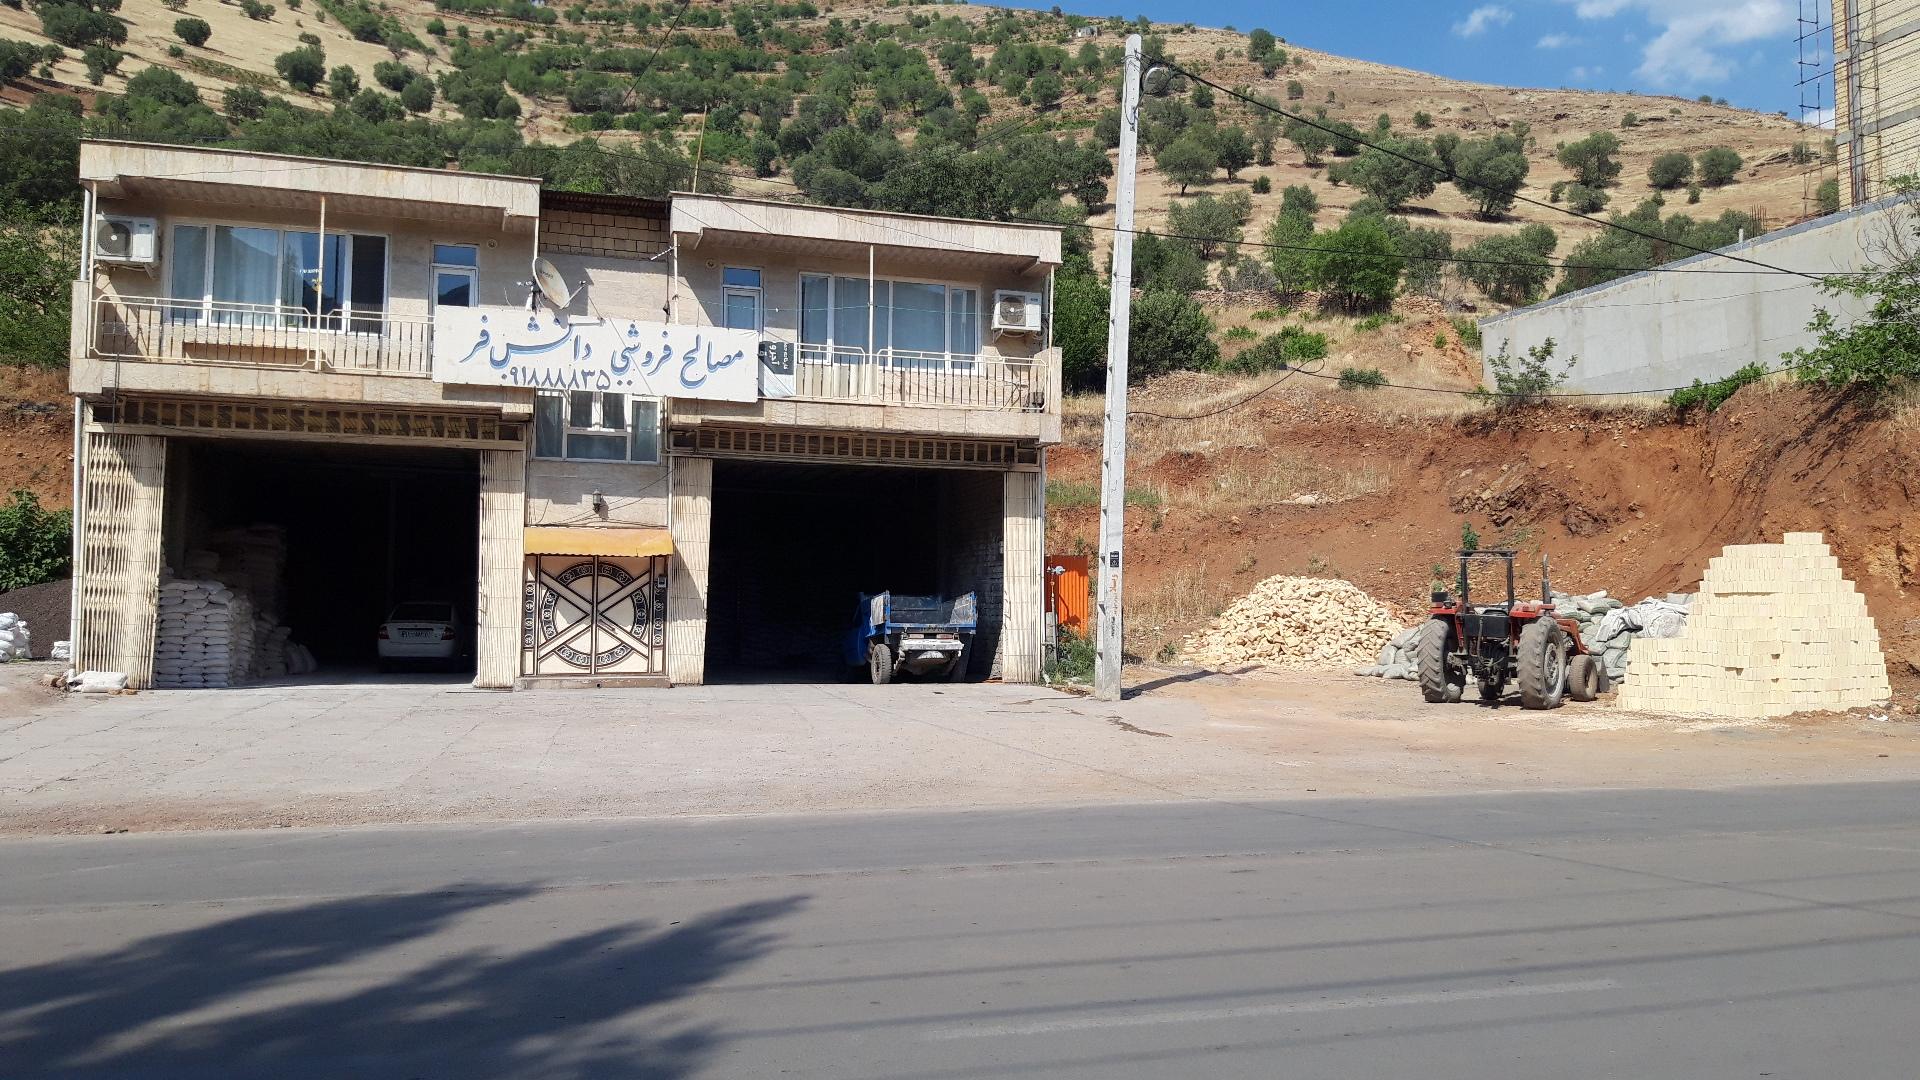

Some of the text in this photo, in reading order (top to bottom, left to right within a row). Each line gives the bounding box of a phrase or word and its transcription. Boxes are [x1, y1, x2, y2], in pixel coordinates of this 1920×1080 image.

[459, 314, 745, 390] مصالح فروشی دانش فر
[501, 366, 633, 391] ۰۹۱۸۸۸۸۳۵۰۰
